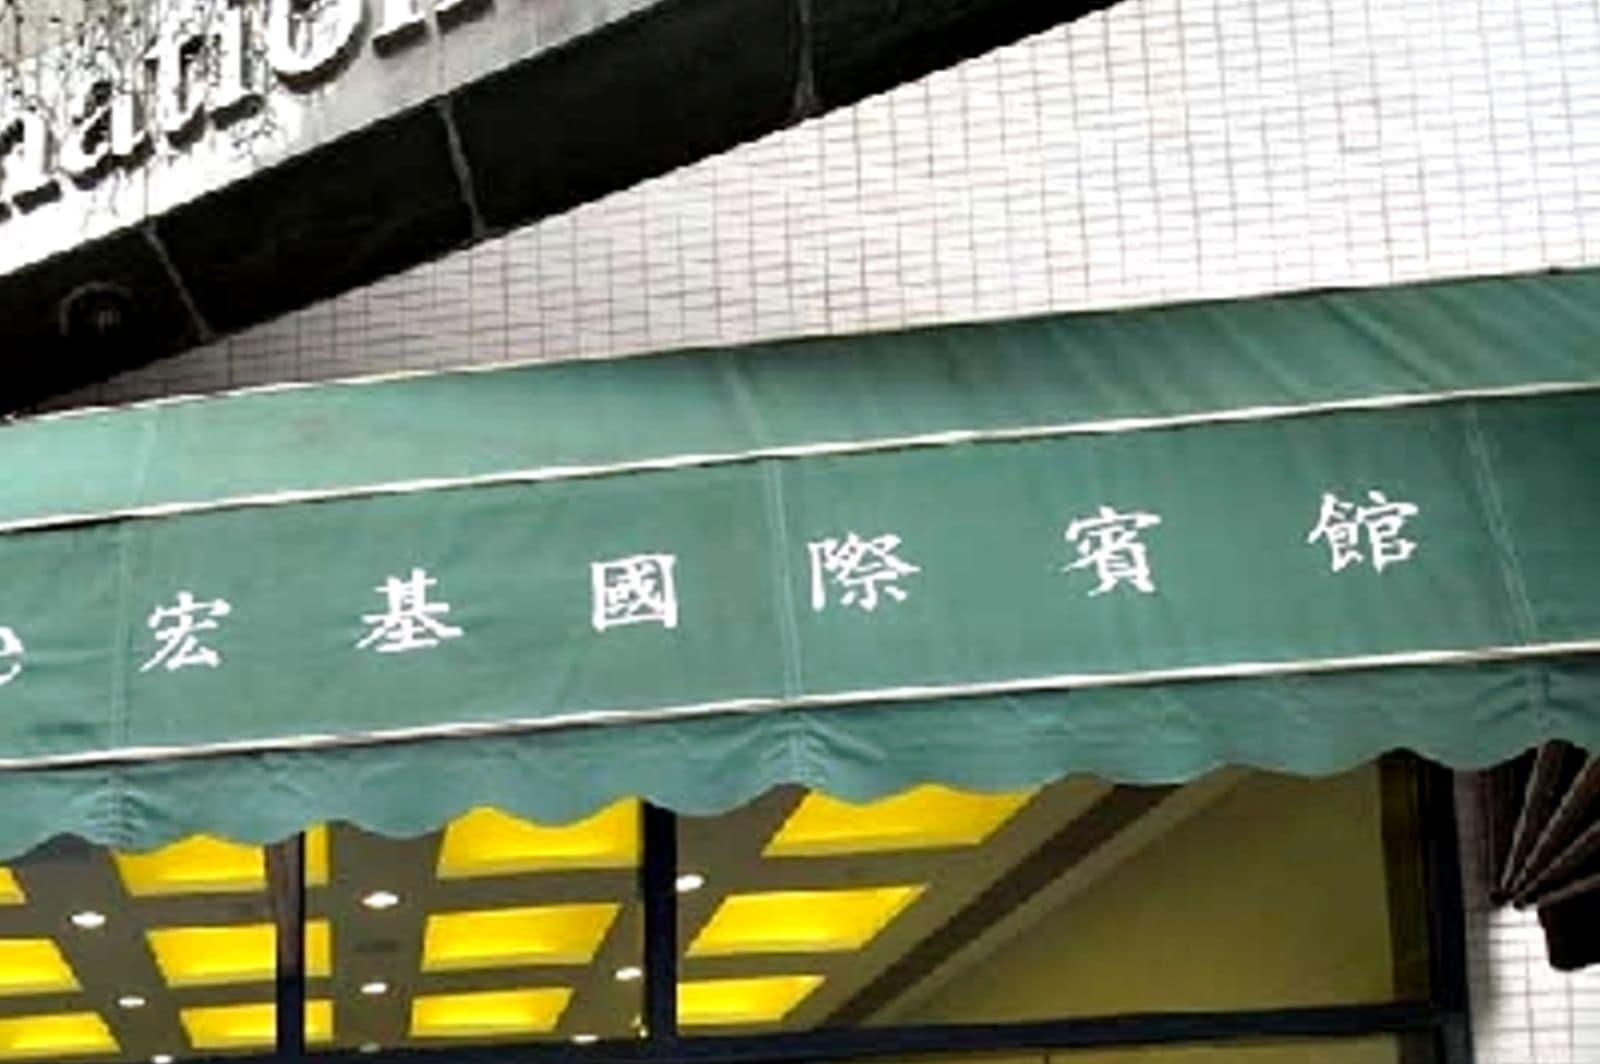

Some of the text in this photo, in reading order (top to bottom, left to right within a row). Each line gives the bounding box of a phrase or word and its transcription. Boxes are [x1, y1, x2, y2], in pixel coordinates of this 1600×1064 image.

[139, 489, 1419, 673] 宏基國際賓館
